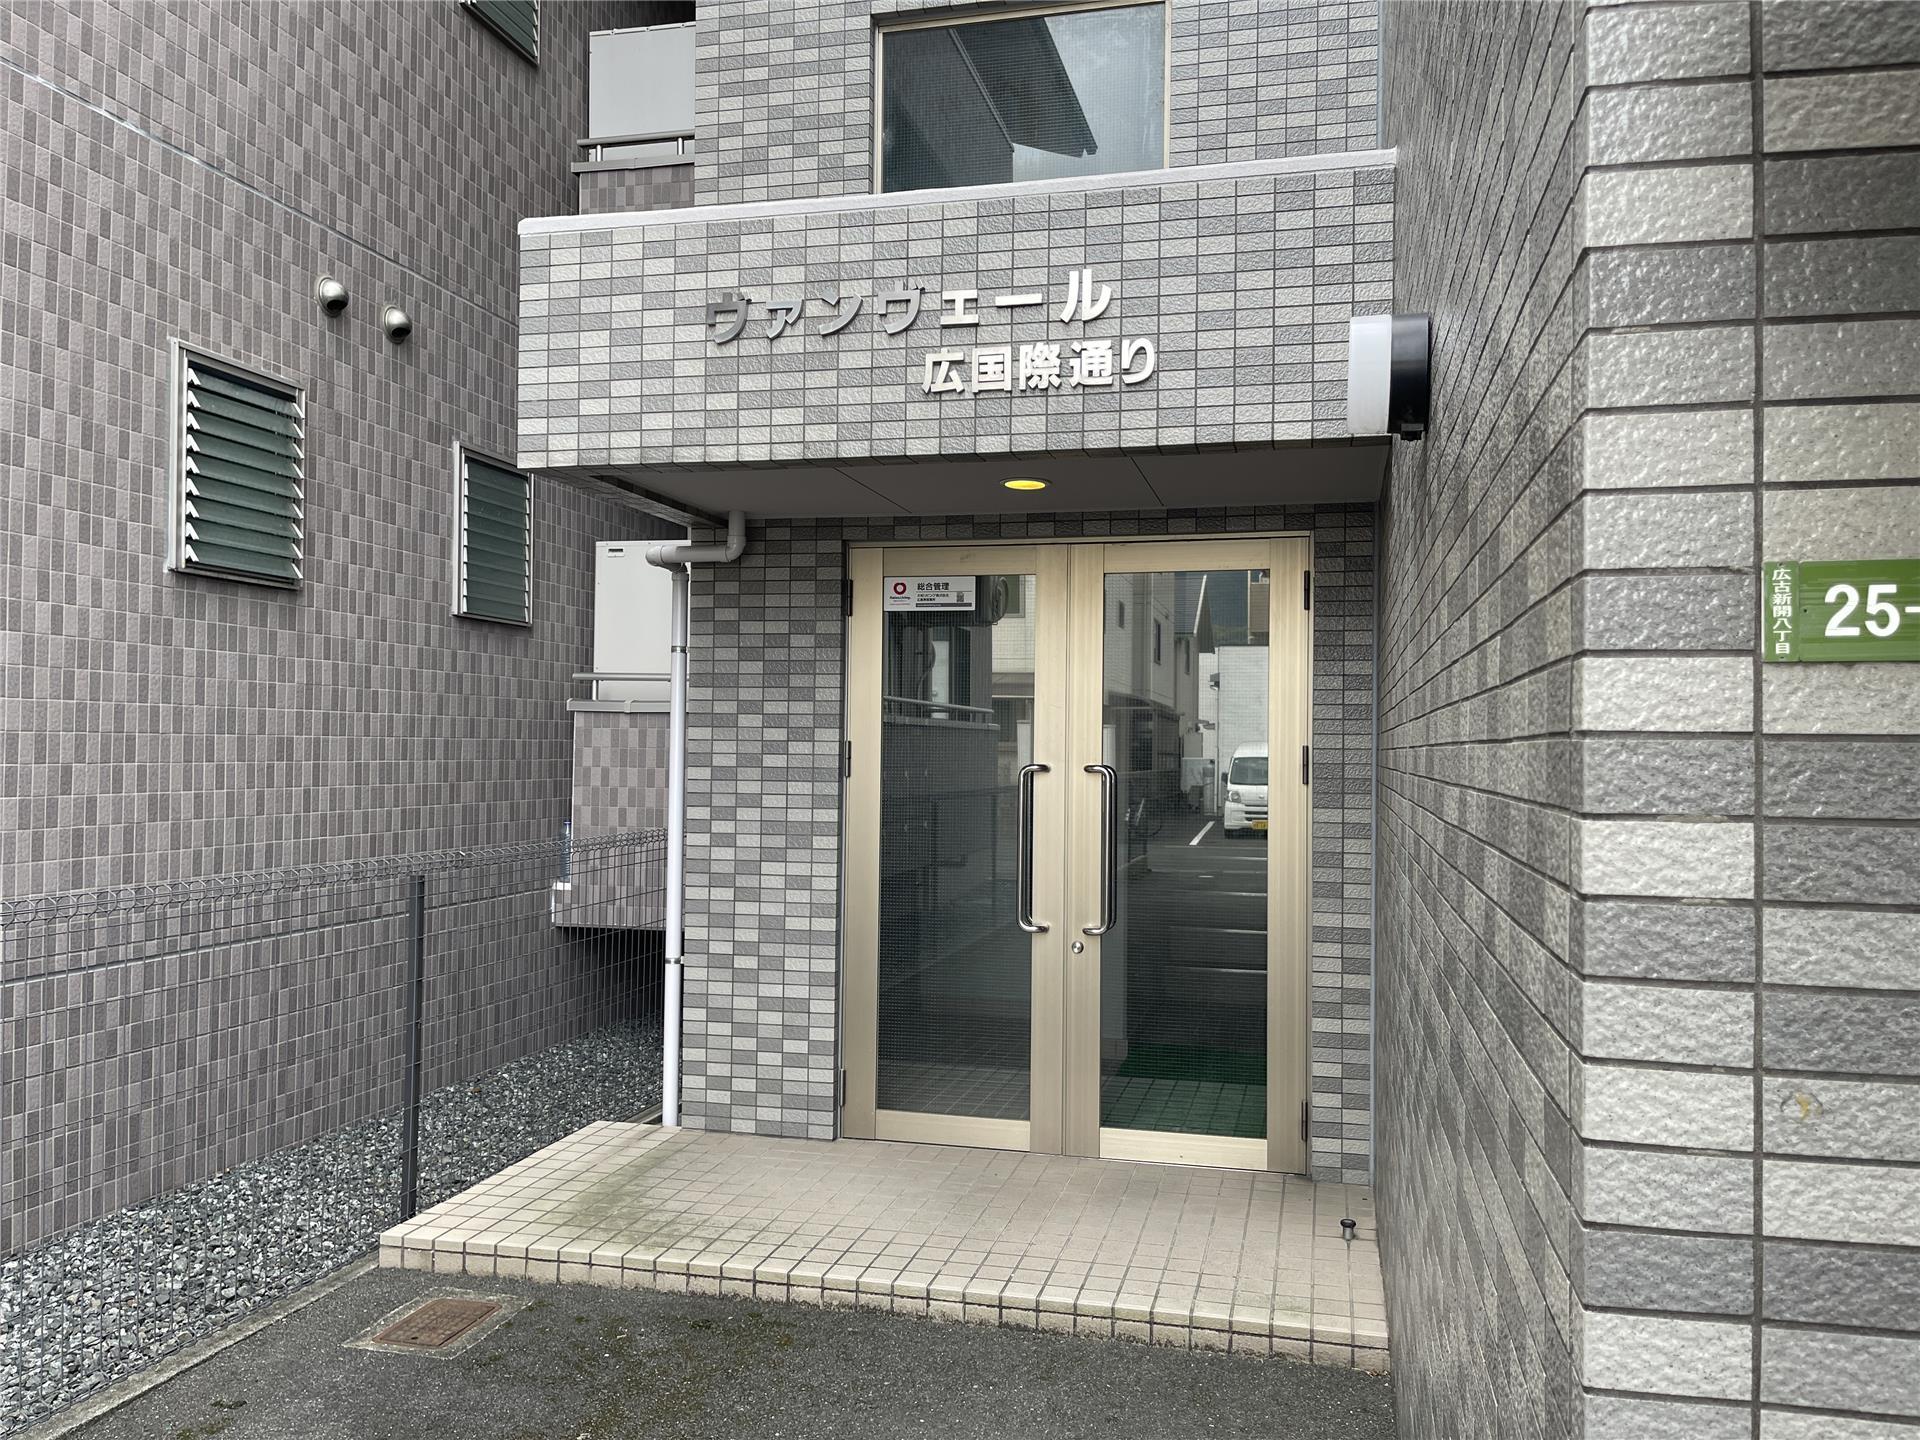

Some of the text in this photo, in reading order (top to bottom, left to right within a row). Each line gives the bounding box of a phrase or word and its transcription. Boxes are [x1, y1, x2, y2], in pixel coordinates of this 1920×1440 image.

[706, 269, 1112, 344] ヴァンヴェール
[922, 337, 1156, 394] 広国際通り
[917, 582, 950, 591] 総合管理
[1772, 568, 1793, 655] 広古新開八丁目
